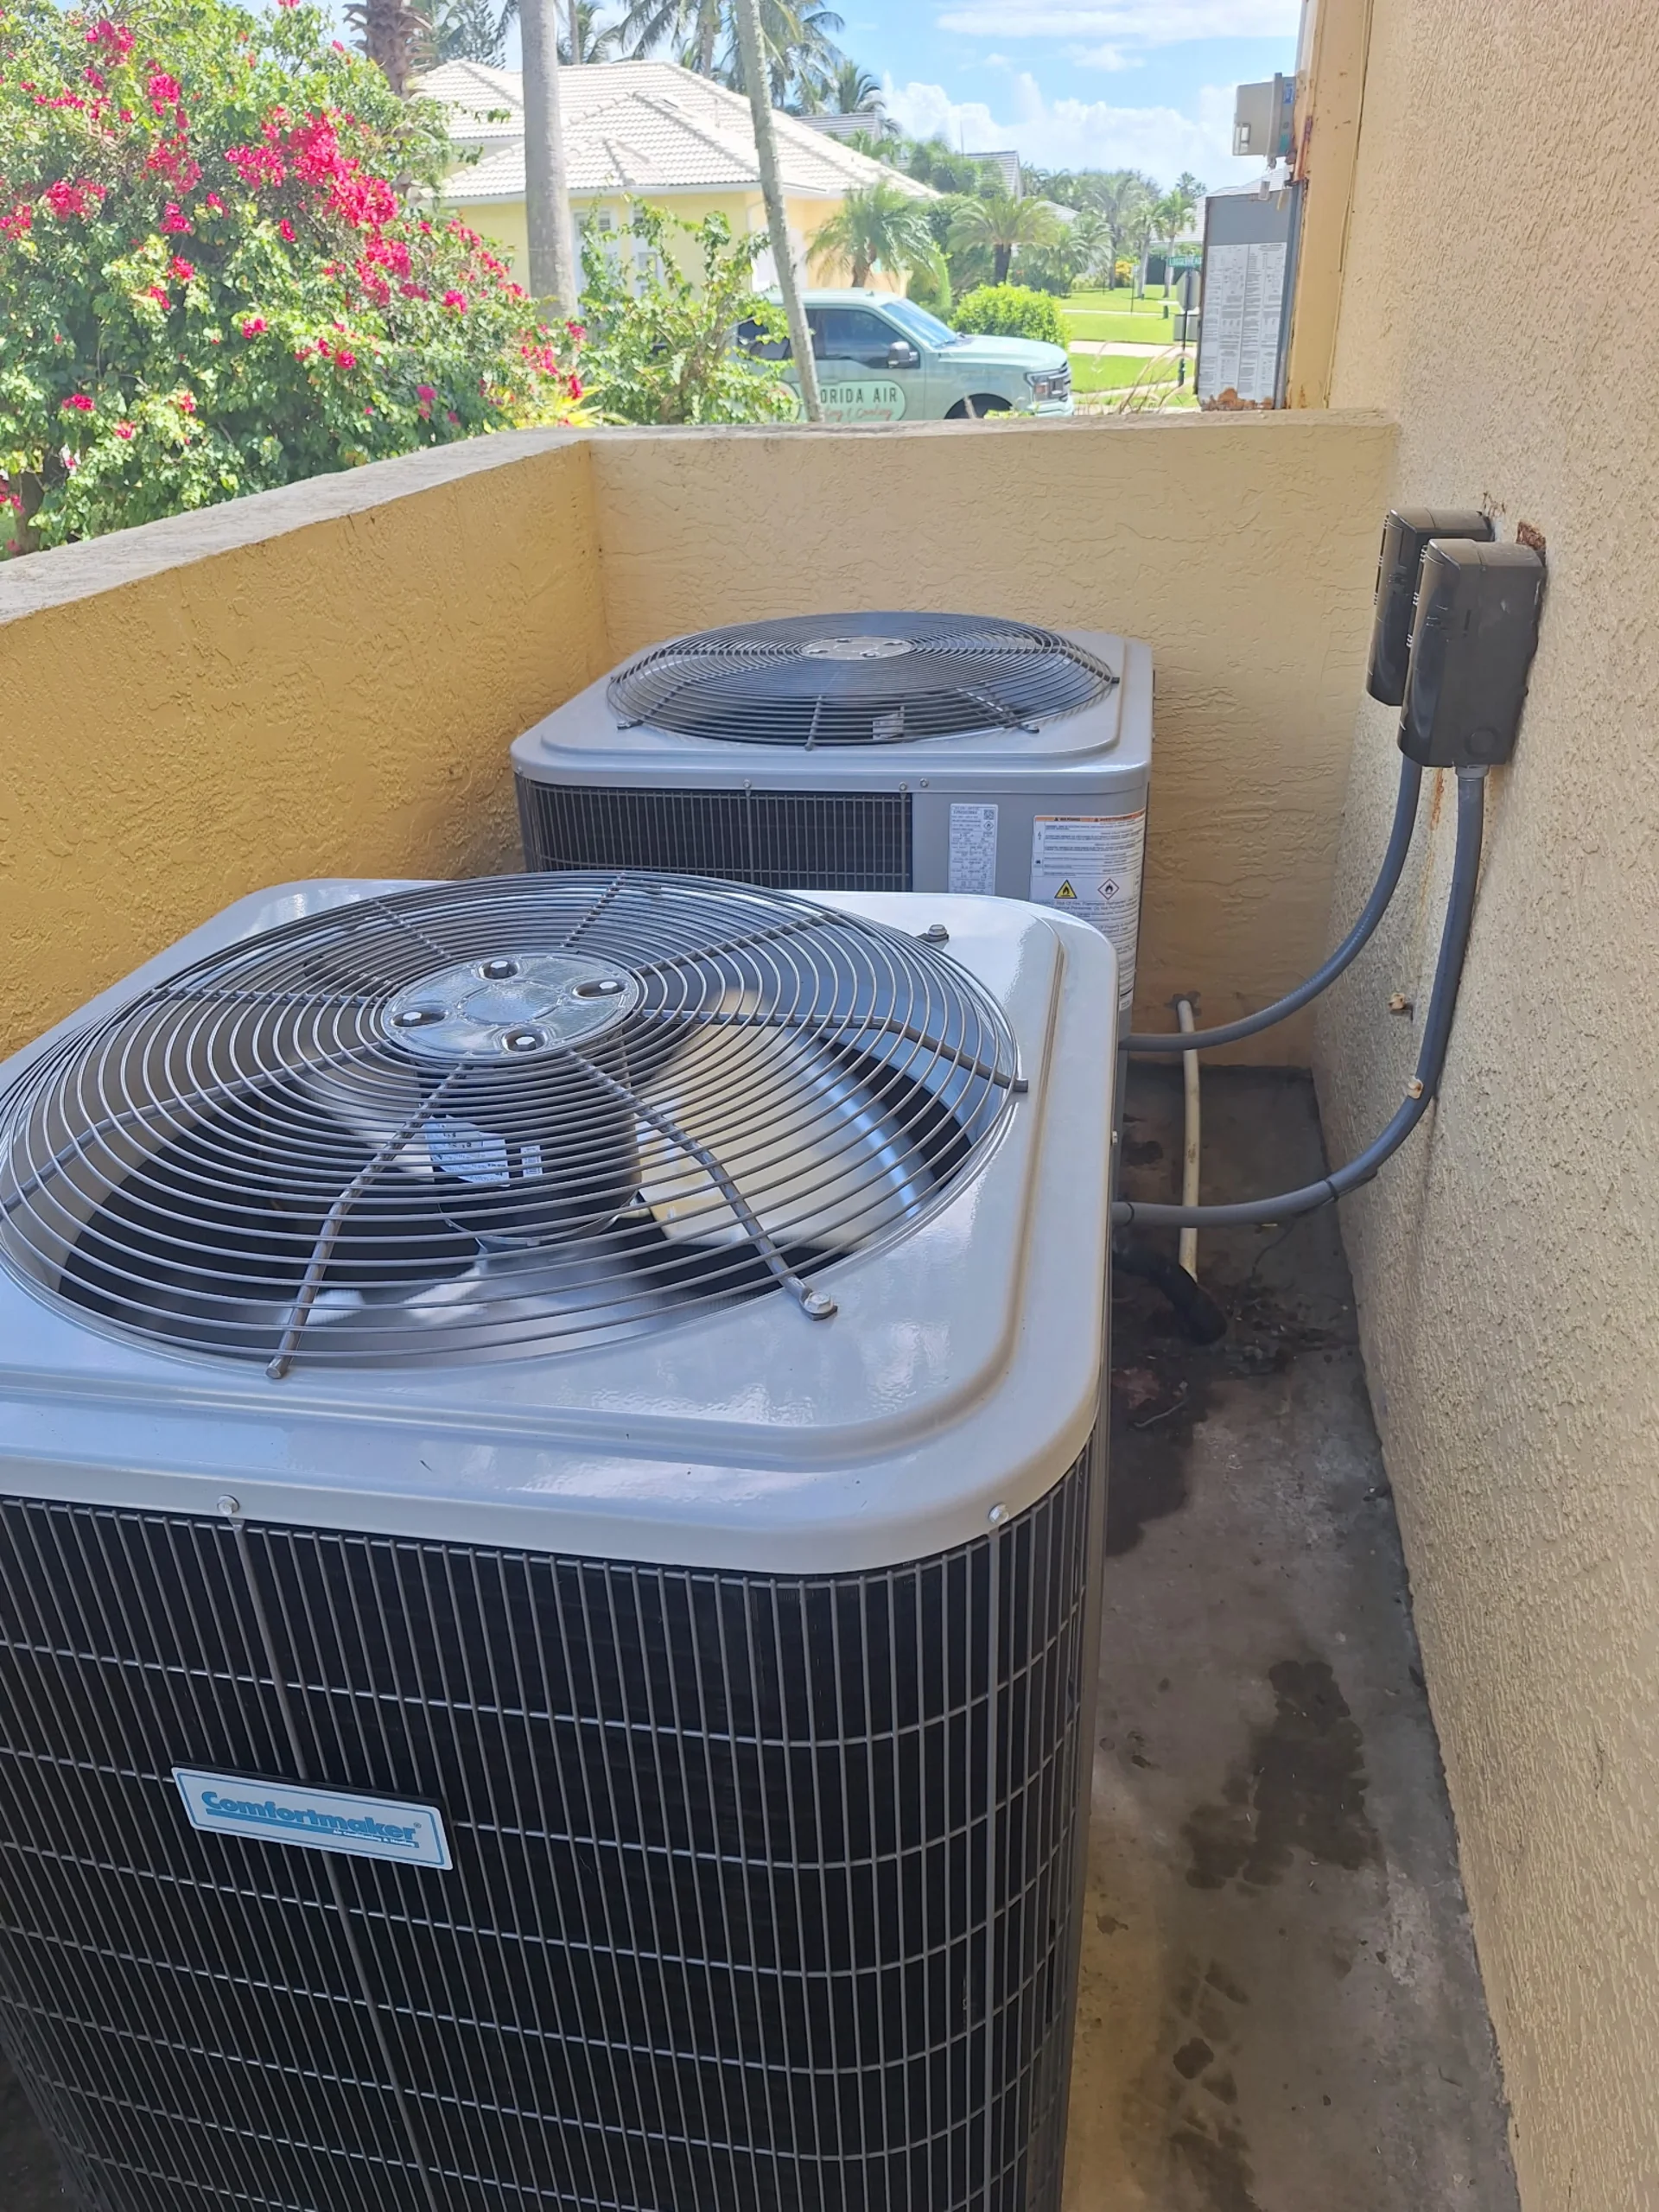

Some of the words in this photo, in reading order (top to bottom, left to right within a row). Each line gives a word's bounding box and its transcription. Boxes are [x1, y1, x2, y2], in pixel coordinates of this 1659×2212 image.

[820, 388, 864, 404] ORIDA
[873, 387, 897, 403] AIR
[201, 1791, 416, 1840] Comfortmaker
